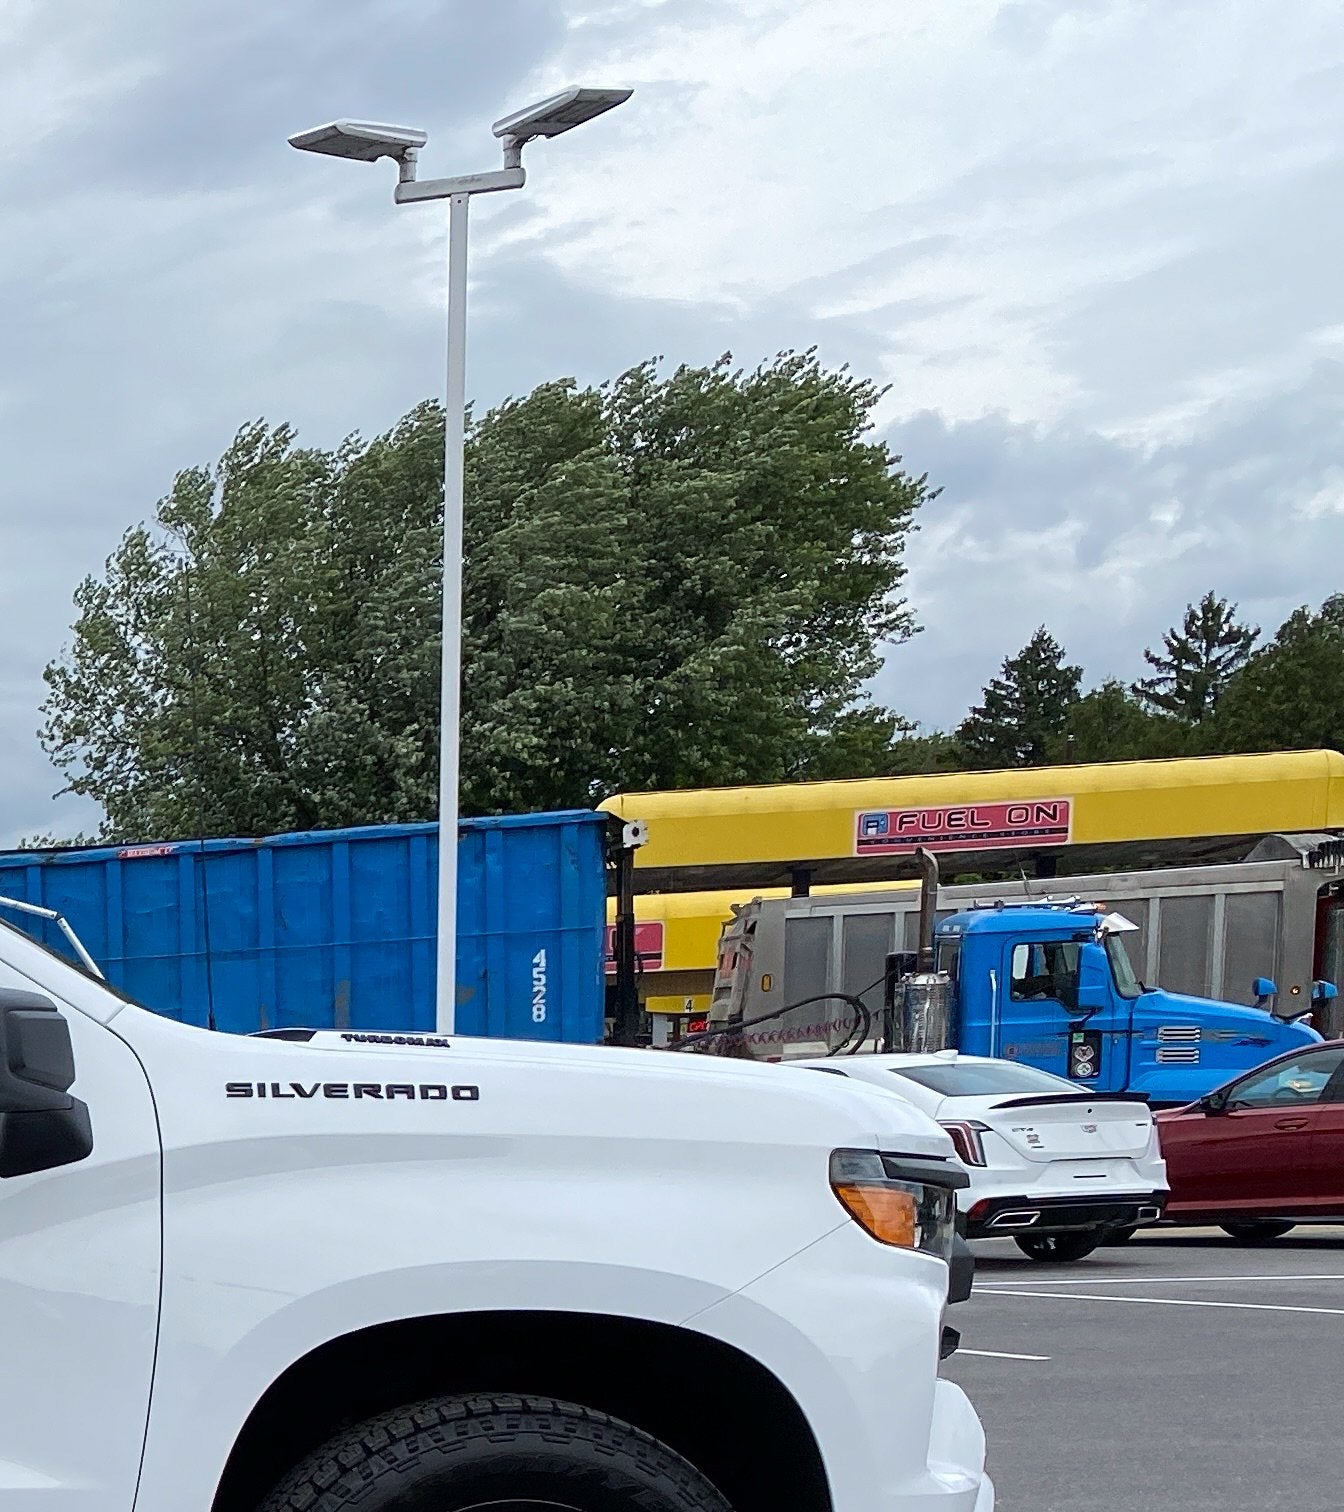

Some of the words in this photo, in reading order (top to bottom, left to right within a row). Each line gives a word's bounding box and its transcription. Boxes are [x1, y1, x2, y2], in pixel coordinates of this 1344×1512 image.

[896, 809, 991, 833] FUEL
[1006, 802, 1059, 827] ON
[532, 948, 547, 1023] 4528
[685, 1000, 693, 1012] 4
[225, 1082, 480, 1101] SILVERADO
